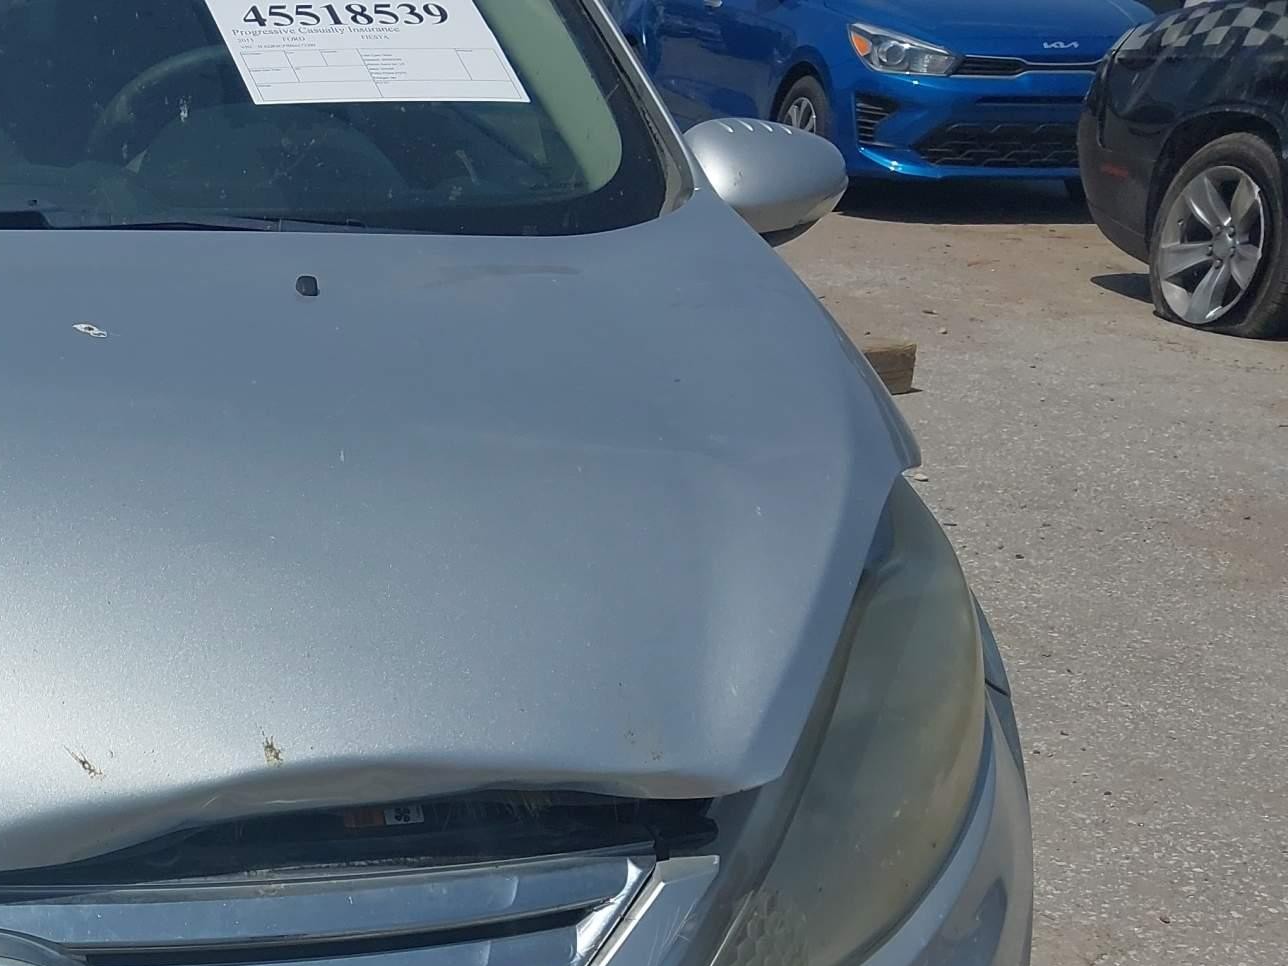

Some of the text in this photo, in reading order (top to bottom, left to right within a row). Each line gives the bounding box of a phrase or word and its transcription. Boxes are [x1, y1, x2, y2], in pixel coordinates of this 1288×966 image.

[243, 3, 449, 27] 45518539
[232, 25, 401, 37] Progressive Casualty Insurance
